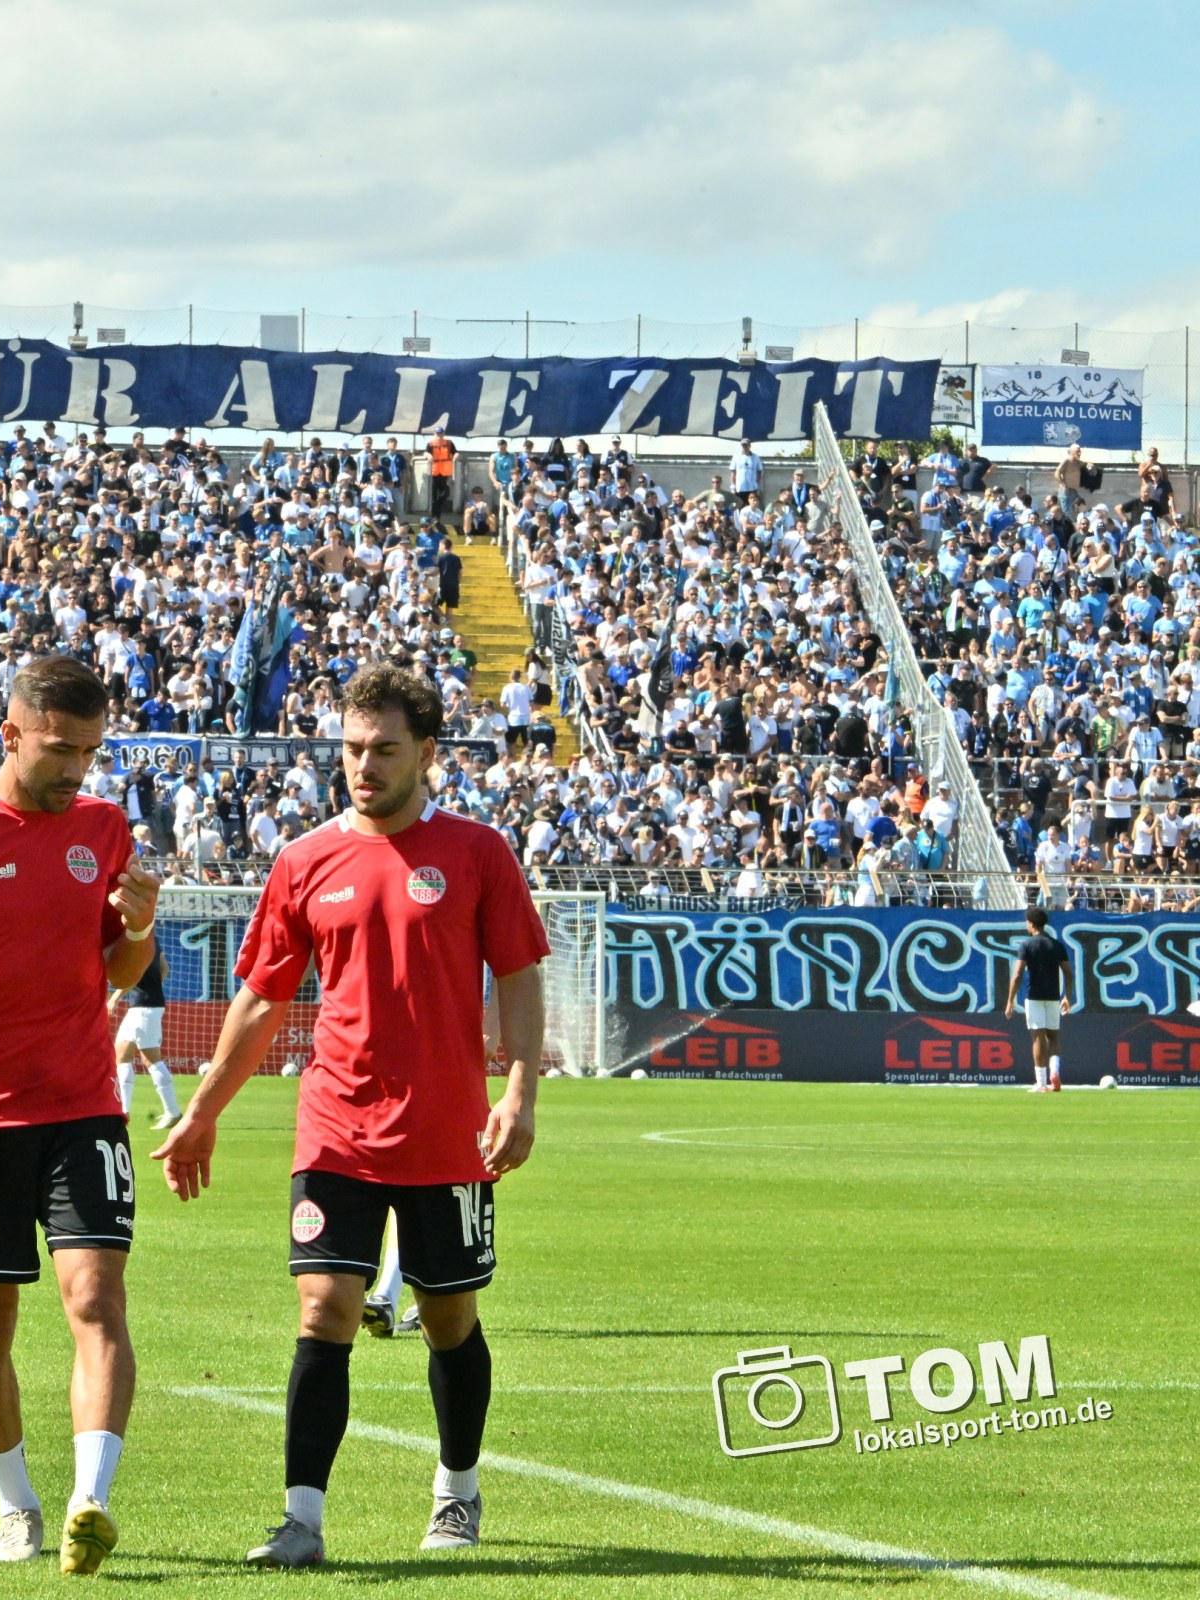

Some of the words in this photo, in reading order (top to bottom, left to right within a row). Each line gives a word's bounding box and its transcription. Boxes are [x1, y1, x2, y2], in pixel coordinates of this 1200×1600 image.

[1027, 371, 1042, 380] 18
[1084, 372, 1101, 382] 60
[204, 359, 542, 438] ALLE
[600, 368, 904, 440] ZEIT
[993, 404, 1075, 419] OBERLAND
[1079, 403, 1132, 421] LÖWEN
[116, 743, 194, 770] 1860
[70, 848, 91, 860] TSV
[414, 868, 439, 880] TSV
[408, 880, 445, 889] LANDSBERG
[319, 886, 354, 903] capelli
[414, 889, 439, 901] 1882
[626, 895, 662, 913] 50+1
[670, 895, 720, 913] MUSS
[650, 1037, 781, 1068] LEIB
[885, 1040, 1014, 1070] LEIB
[650, 1070, 704, 1079] Spenglerei
[715, 1071, 783, 1081] Bedachungen
[885, 1072, 938, 1082] Spenglerei
[949, 1073, 1016, 1082] Bedachungen
[1117, 1074, 1169, 1084] Spenglerei
[1180, 1075, 1200, 1083] Bed
[95, 1139, 134, 1204] 19
